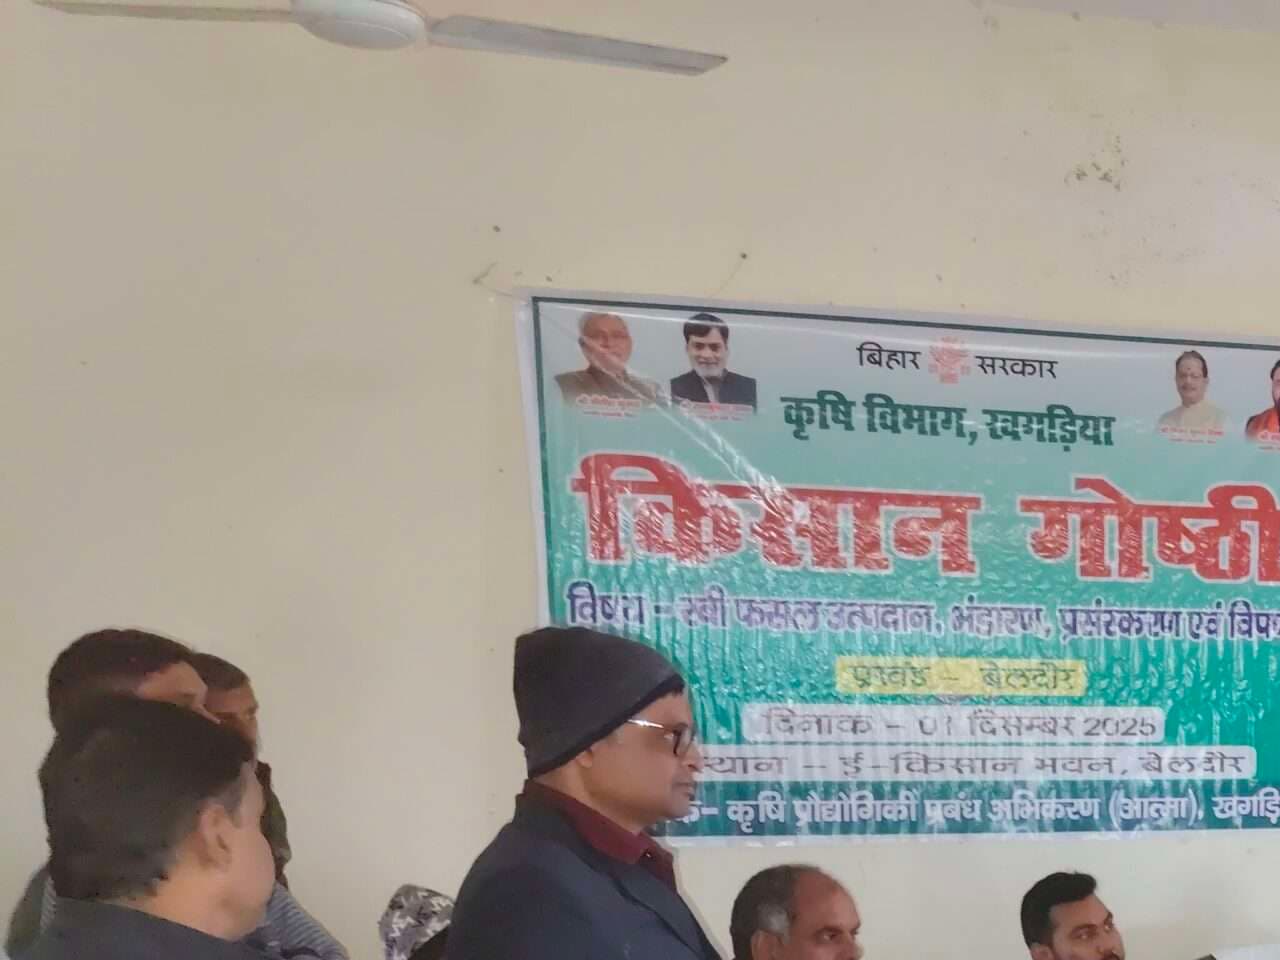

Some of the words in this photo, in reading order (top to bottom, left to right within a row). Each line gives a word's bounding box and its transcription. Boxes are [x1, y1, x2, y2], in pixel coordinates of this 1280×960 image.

[856, 342, 921, 370] बिहार
[975, 355, 1058, 379] सरकार
[780, 390, 855, 440] कृषि
[863, 393, 978, 445] विभाग,
[982, 404, 1116, 451] खगड़िया
[572, 453, 982, 576] किसान
[678, 585, 727, 627] रबी
[735, 599, 821, 630] फसल
[1188, 600, 1222, 640] एवं
[1083, 717, 1156, 737] 2025
[1139, 752, 1246, 774] बेलदौर
[726, 791, 786, 833] कृषि
